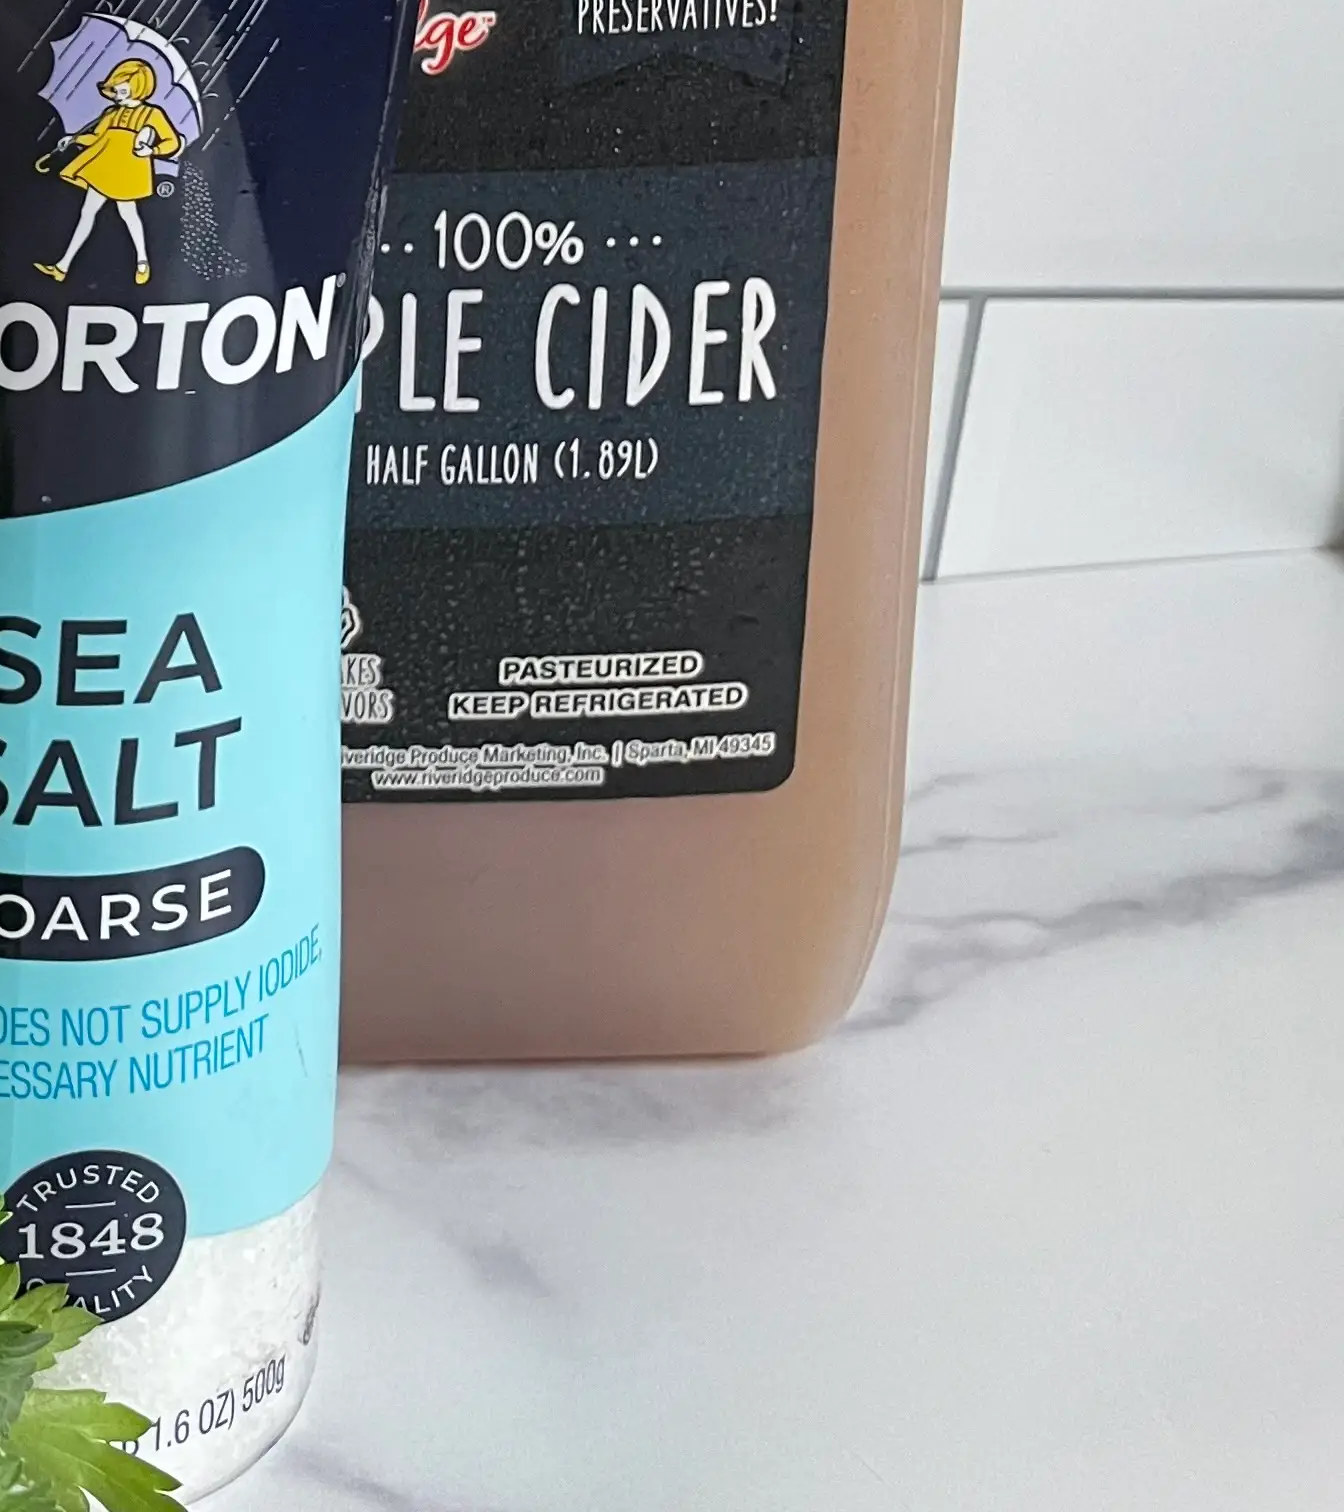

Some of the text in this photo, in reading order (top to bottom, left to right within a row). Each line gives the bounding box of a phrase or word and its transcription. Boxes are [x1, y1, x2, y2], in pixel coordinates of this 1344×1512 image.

[433, 210, 585, 271] 100%
[534, 277, 778, 411] CIDER
[366, 444, 428, 486] HALF
[440, 442, 539, 485] GALLON
[503, 654, 698, 681] PASTEURIZED
[453, 686, 744, 715] KEEP REFRIGERATED
[411, 747, 478, 765] Produce
[577, 743, 607, 760] Inc.
[628, 741, 688, 761] Sparta,
[693, 739, 713, 755] MI
[717, 734, 772, 754] 49345
[374, 767, 601, 788] www.riveridgeproduce.com
[62, 1004, 131, 1047] NOT
[142, 970, 252, 1039] SUPPLY
[129, 1014, 269, 1095] NUTRIENT
[16, 1164, 160, 1214] TRUSTED
[17, 1212, 165, 1260] 1848
[198, 1353, 286, 1436] OZ) 500g
